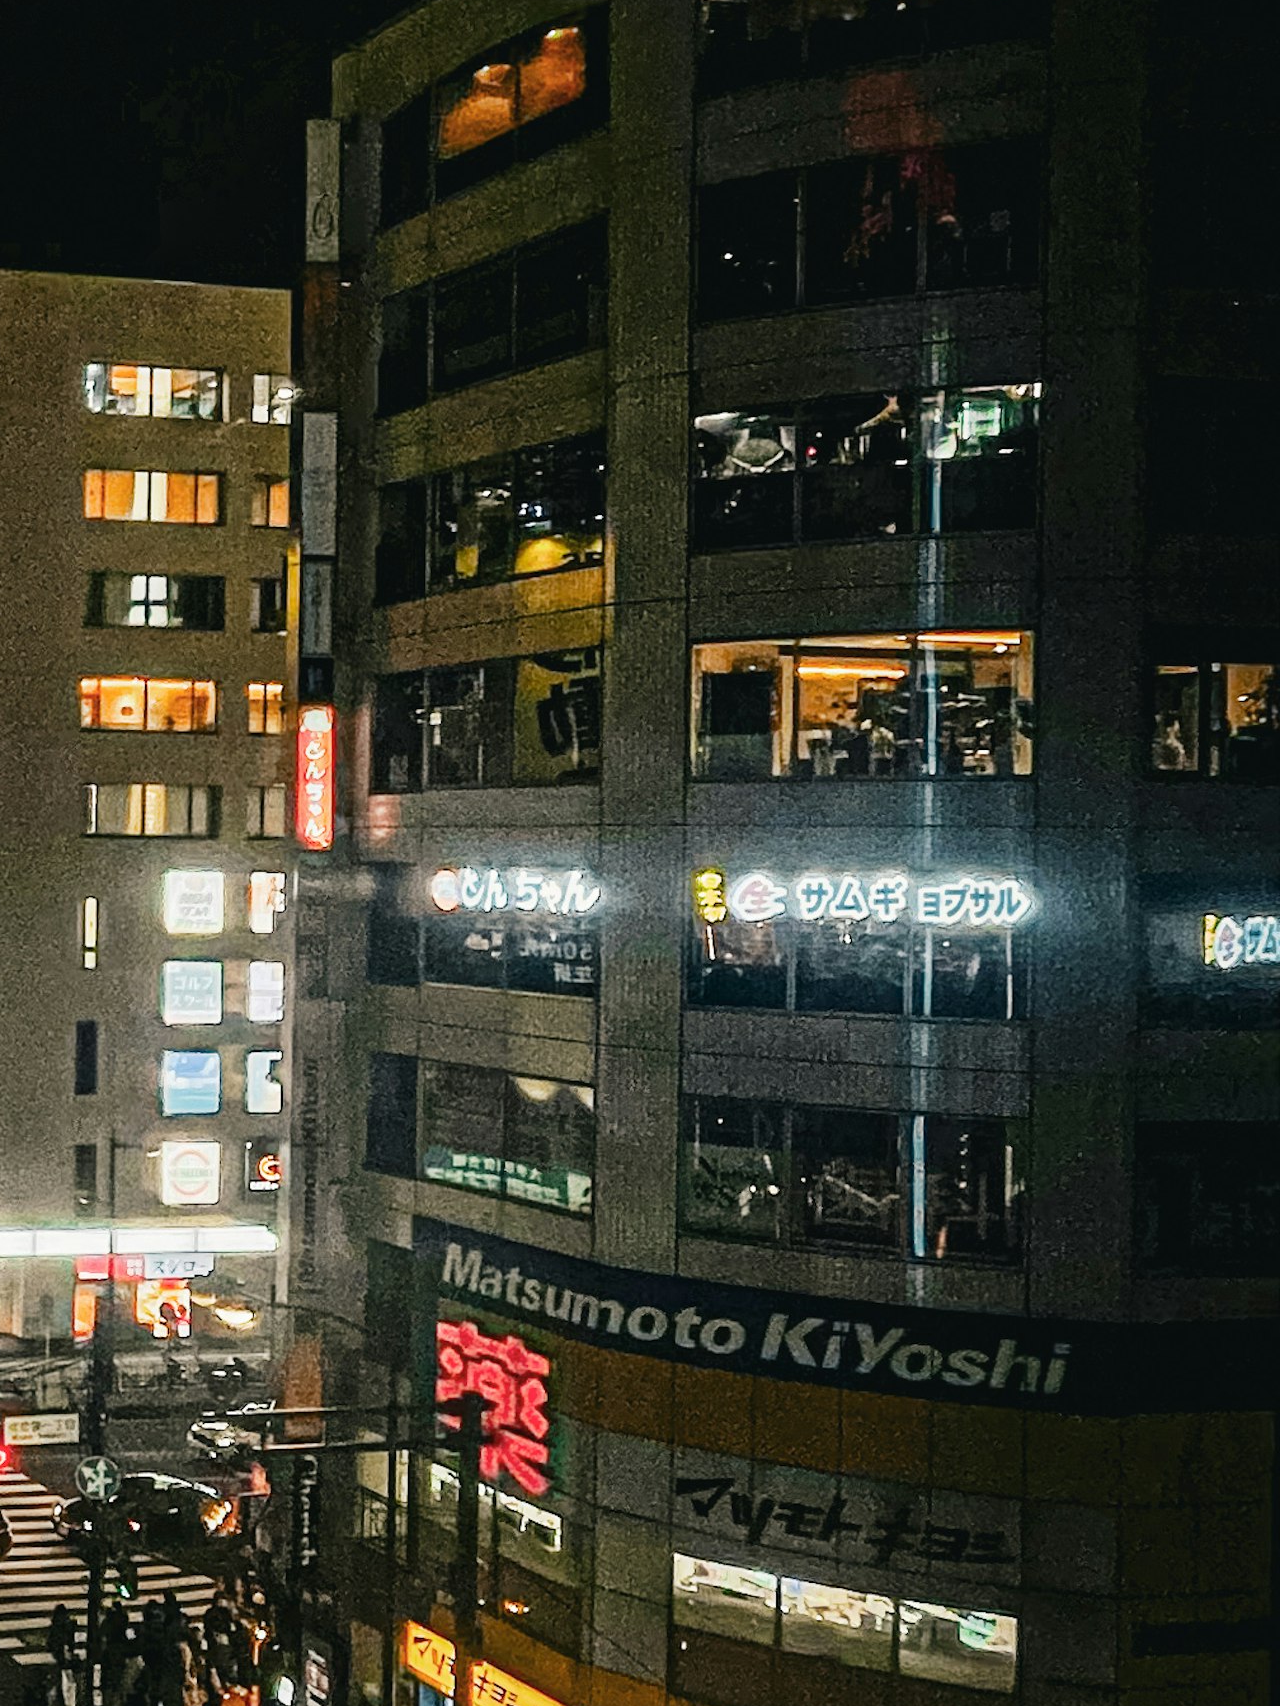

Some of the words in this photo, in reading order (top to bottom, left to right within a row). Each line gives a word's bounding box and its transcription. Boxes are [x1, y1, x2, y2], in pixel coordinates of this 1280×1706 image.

[171, 995, 217, 1007] スクール
[174, 976, 213, 990] ゴルフ
[440, 1242, 746, 1355] Matsumoto
[761, 1312, 1072, 1395] KiYoshi
[675, 1475, 1023, 1565] マツモトキヨシ
